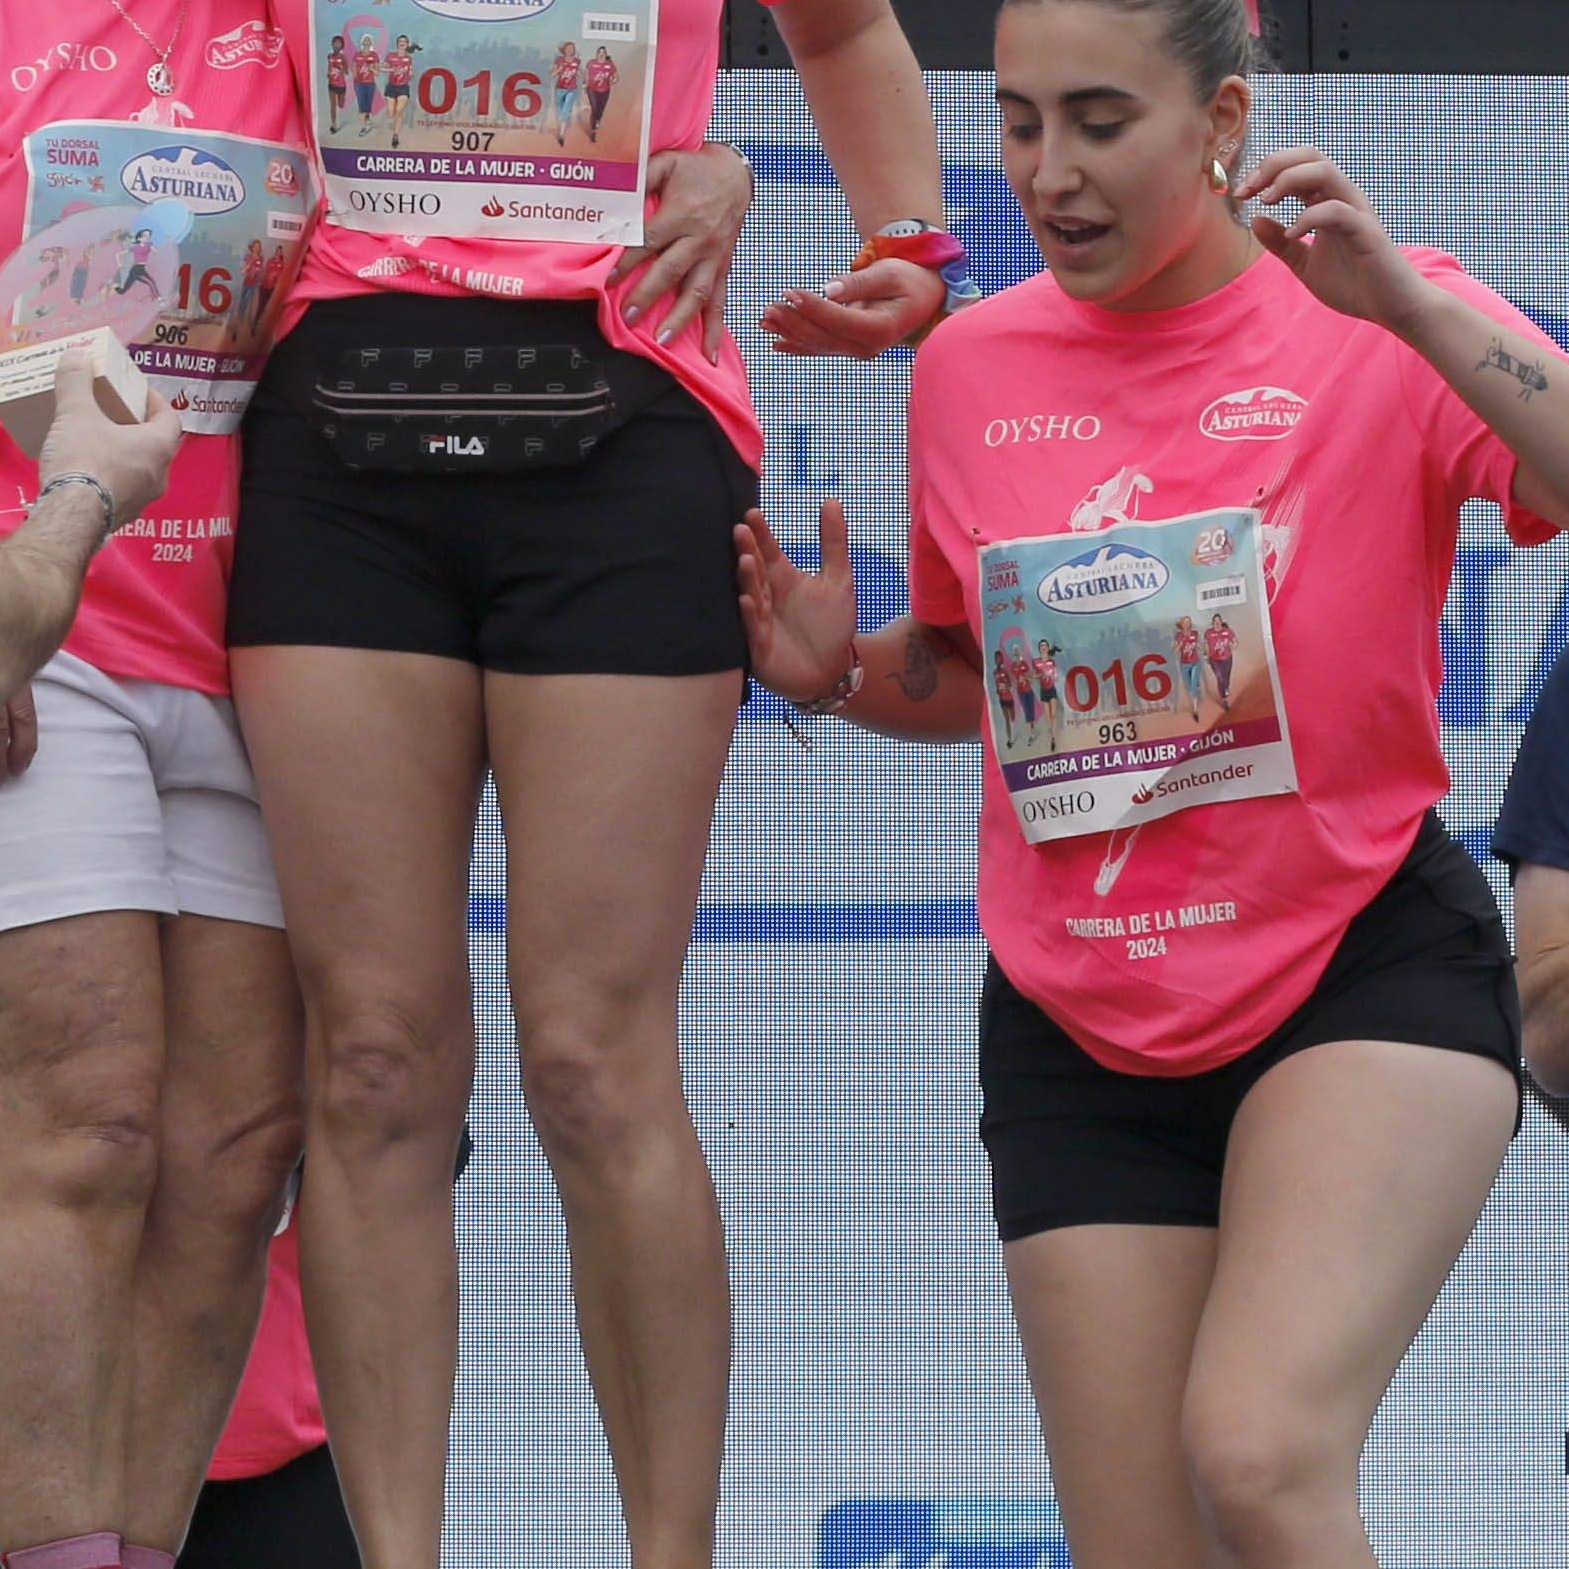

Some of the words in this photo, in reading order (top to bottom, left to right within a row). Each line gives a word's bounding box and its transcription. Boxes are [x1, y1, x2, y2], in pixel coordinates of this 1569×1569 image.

[10, 42, 118, 92] OYSHO
[417, 68, 543, 118] 016
[451, 131, 495, 152] 907
[47, 149, 99, 166] SUMA
[356, 156, 425, 176] CARRERA
[430, 157, 451, 175] DE
[455, 158, 475, 176] LA
[479, 159, 535, 178] MUJER
[550, 161, 595, 181] GIJÓN
[131, 166, 237, 202] ASTURIANA
[271, 162, 294, 184] 20
[350, 190, 441, 216] OYSHO
[508, 200, 604, 223] Santander
[178, 263, 233, 314] 16
[465, 270, 524, 296] MUJER
[135, 351, 152, 366] DE
[156, 352, 171, 368] LA
[175, 354, 217, 373] MUJER
[984, 415, 1101, 447] OYSHO
[424, 435, 485, 456] FILA
[161, 519, 182, 538] DE
[187, 519, 206, 538] LA
[152, 543, 194, 562] 2024
[987, 571, 1019, 592] SUMA
[1046, 572, 1159, 603] ASTURIANA
[1064, 654, 1172, 713] 016
[1098, 721, 1137, 745] 963
[1027, 756, 1078, 781] CARRERA
[1082, 753, 1100, 770] DE
[1104, 750, 1123, 767] LA
[1127, 744, 1177, 765] MUJER
[1190, 729, 1234, 752] GIJÓN
[1022, 791, 1095, 824] OYSHO
[1156, 763, 1254, 798] Santander
[1066, 917, 1125, 939] CARRERA
[1130, 915, 1152, 935] DE
[1155, 912, 1175, 931] LA
[1179, 902, 1236, 927] MUJER
[1126, 937, 1167, 961] 2024
